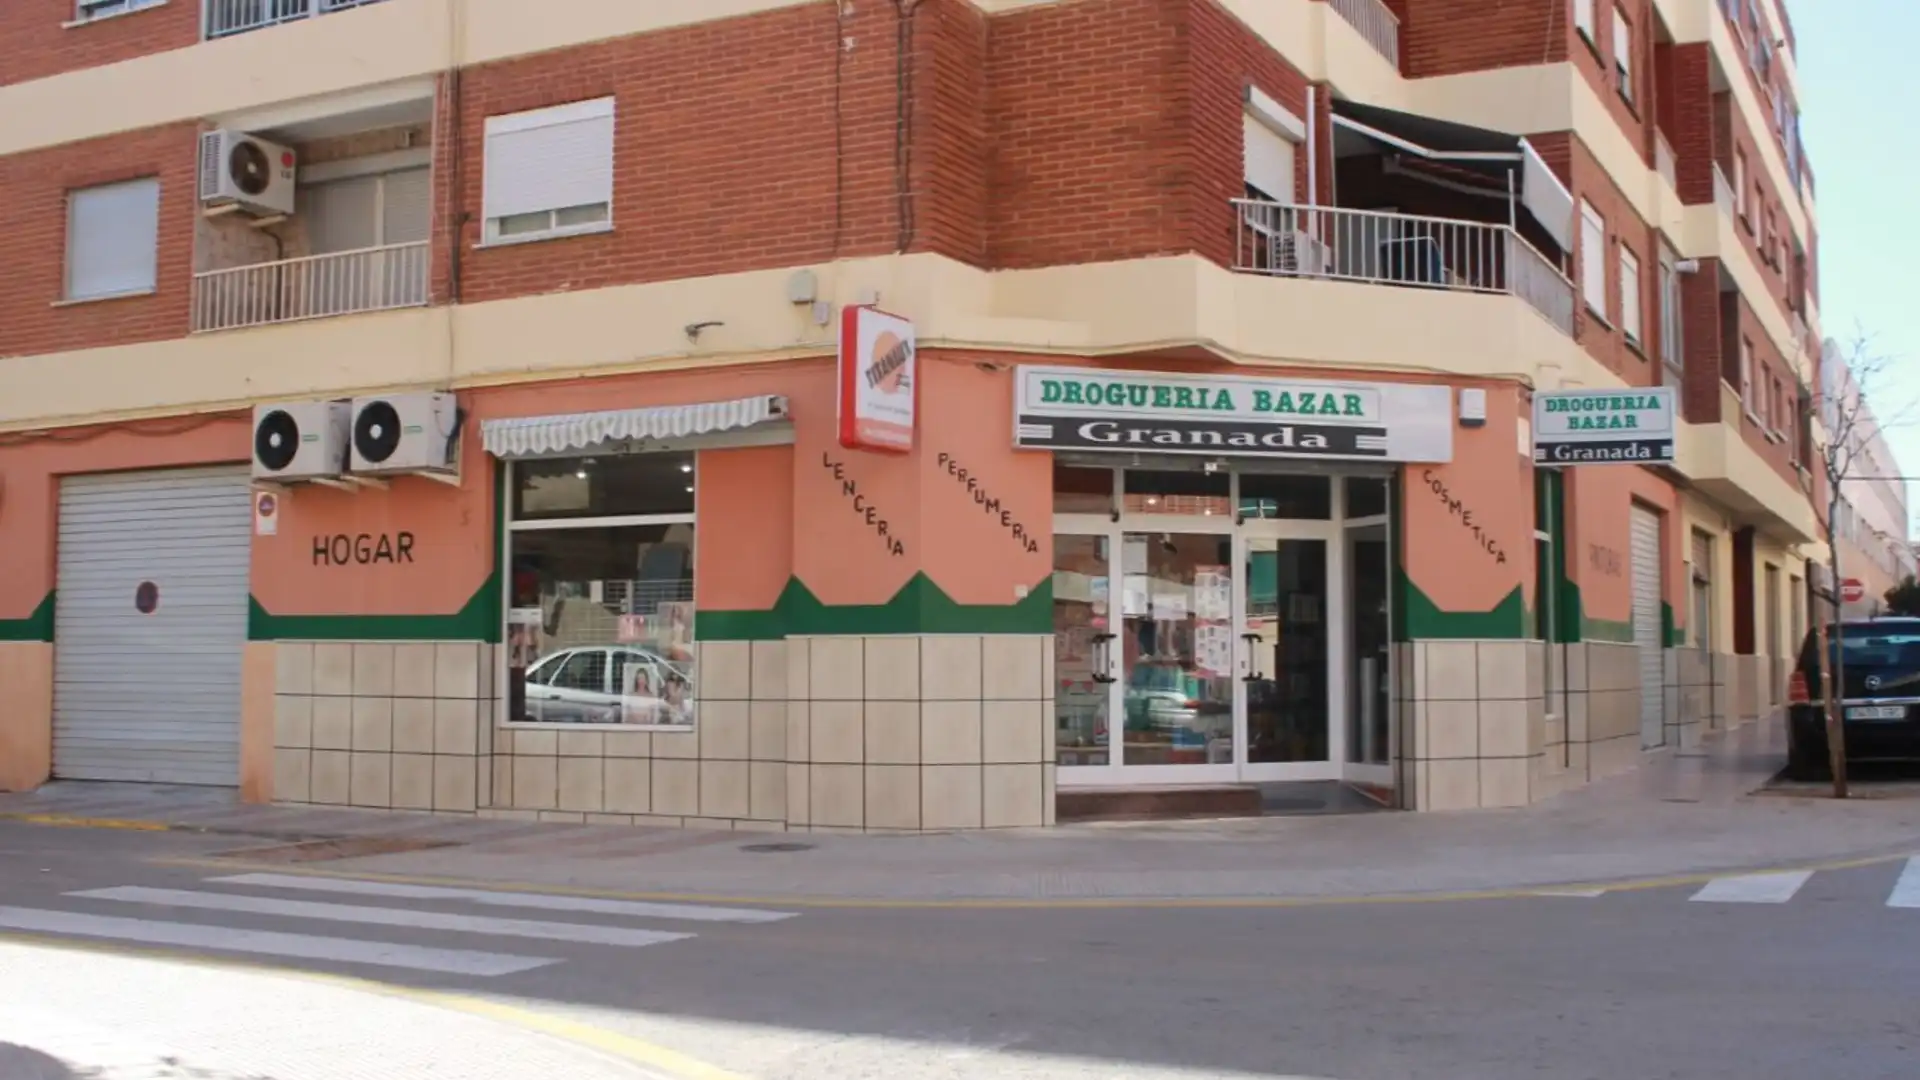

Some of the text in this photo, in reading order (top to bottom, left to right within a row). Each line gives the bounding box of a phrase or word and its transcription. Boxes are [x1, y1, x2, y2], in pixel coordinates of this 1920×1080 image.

[1040, 380, 1364, 416] DROGUERIA BAZAR
[1545, 396, 1661, 412] DROGUERIA
[1078, 421, 1329, 449] Granada
[1567, 415, 1638, 429] BAZAR
[1554, 442, 1652, 460] Granada
[823, 452, 904, 556] LENCERIA
[938, 453, 1038, 553] PERFUMERIA
[1423, 469, 1506, 564] COSMETICA
[313, 531, 415, 567] HOGAR
